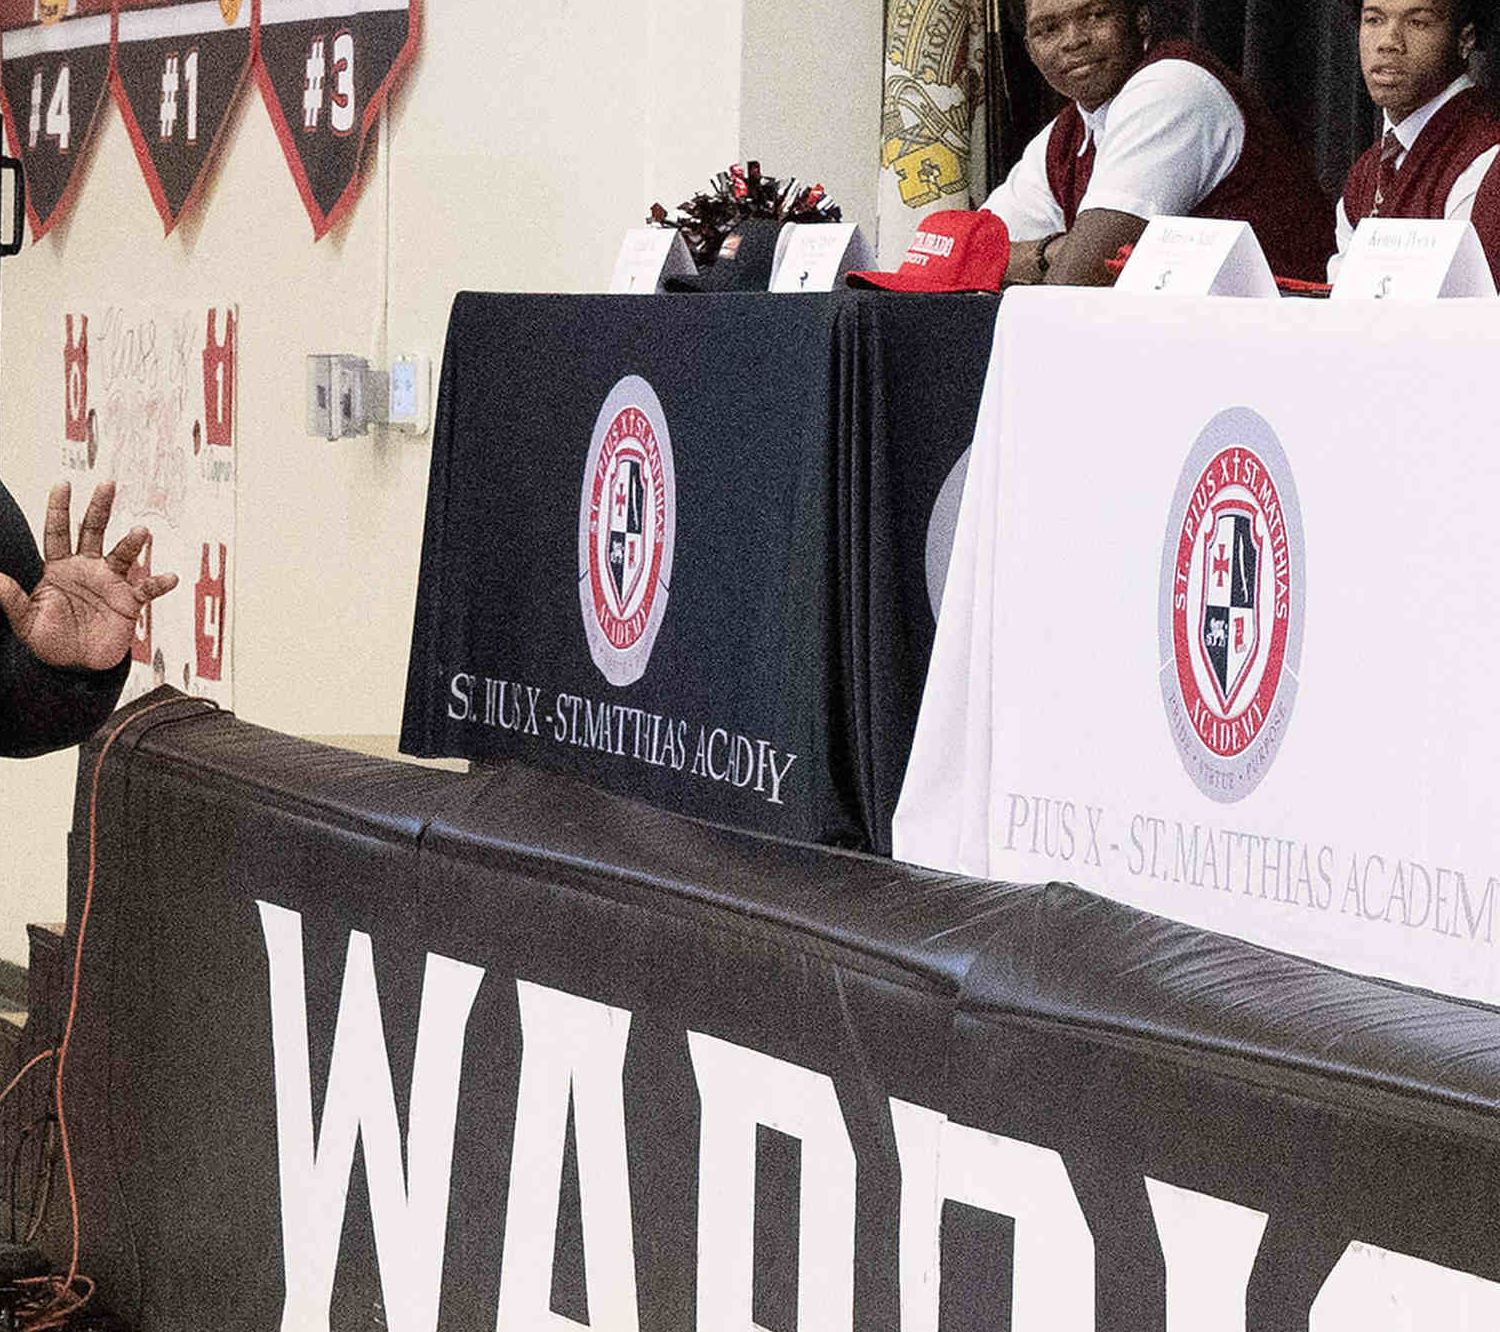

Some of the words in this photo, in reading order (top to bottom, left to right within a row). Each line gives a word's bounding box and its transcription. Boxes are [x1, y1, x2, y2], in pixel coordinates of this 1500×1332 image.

[159, 47, 200, 147] #1
[302, 27, 356, 138] #3
[1175, 561, 1191, 612] ST.
[1184, 466, 1217, 543] PIUS
[1220, 457, 1232, 483] X
[1242, 456, 1260, 494] ST.
[1256, 485, 1291, 620] MATTHIAS
[523, 686, 541, 736] X
[1188, 691, 1266, 752] ACADEMY
[1003, 792, 1076, 862] PIUS
[1083, 805, 1104, 868] X
[1339, 851, 1500, 948] ACADEM
